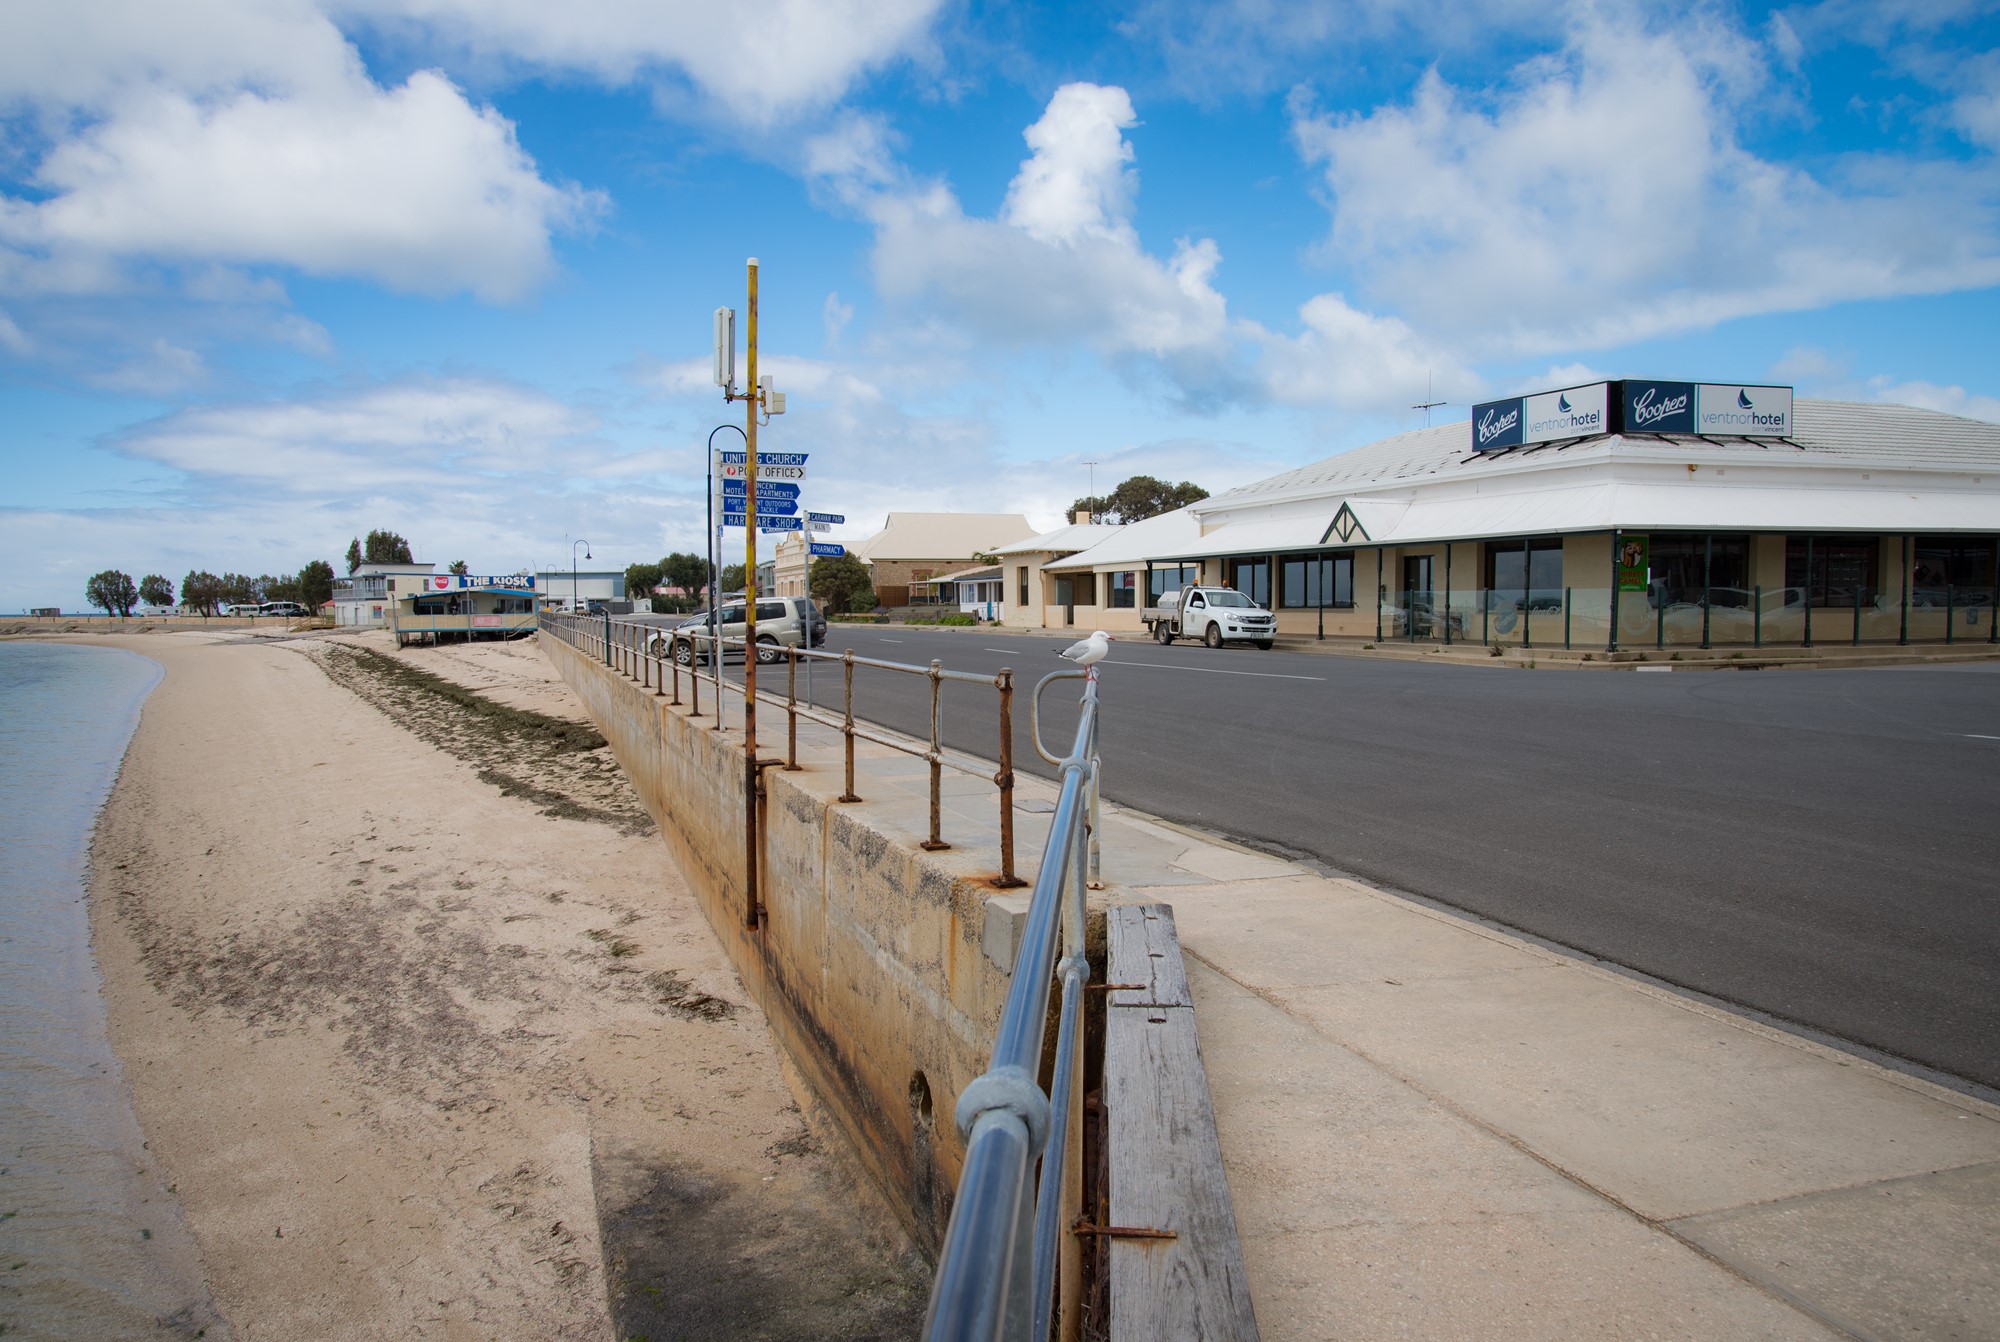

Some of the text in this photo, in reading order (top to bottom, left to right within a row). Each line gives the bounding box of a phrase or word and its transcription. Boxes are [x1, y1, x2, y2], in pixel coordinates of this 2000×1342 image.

[1634, 388, 1687, 427] Coopers
[1478, 408, 1518, 445] Coopers
[725, 453, 802, 465] UNITG CHURCH
[738, 466, 795, 478] PT OFFICE
[756, 482, 777, 490] INCENT
[725, 487, 794, 499] MOTEL APARTMENTS
[760, 506, 779, 514] TACKLE
[728, 515, 796, 529] HARARE SHOP
[812, 544, 841, 555] PHARMACY
[464, 576, 530, 588] THE KIOSK
